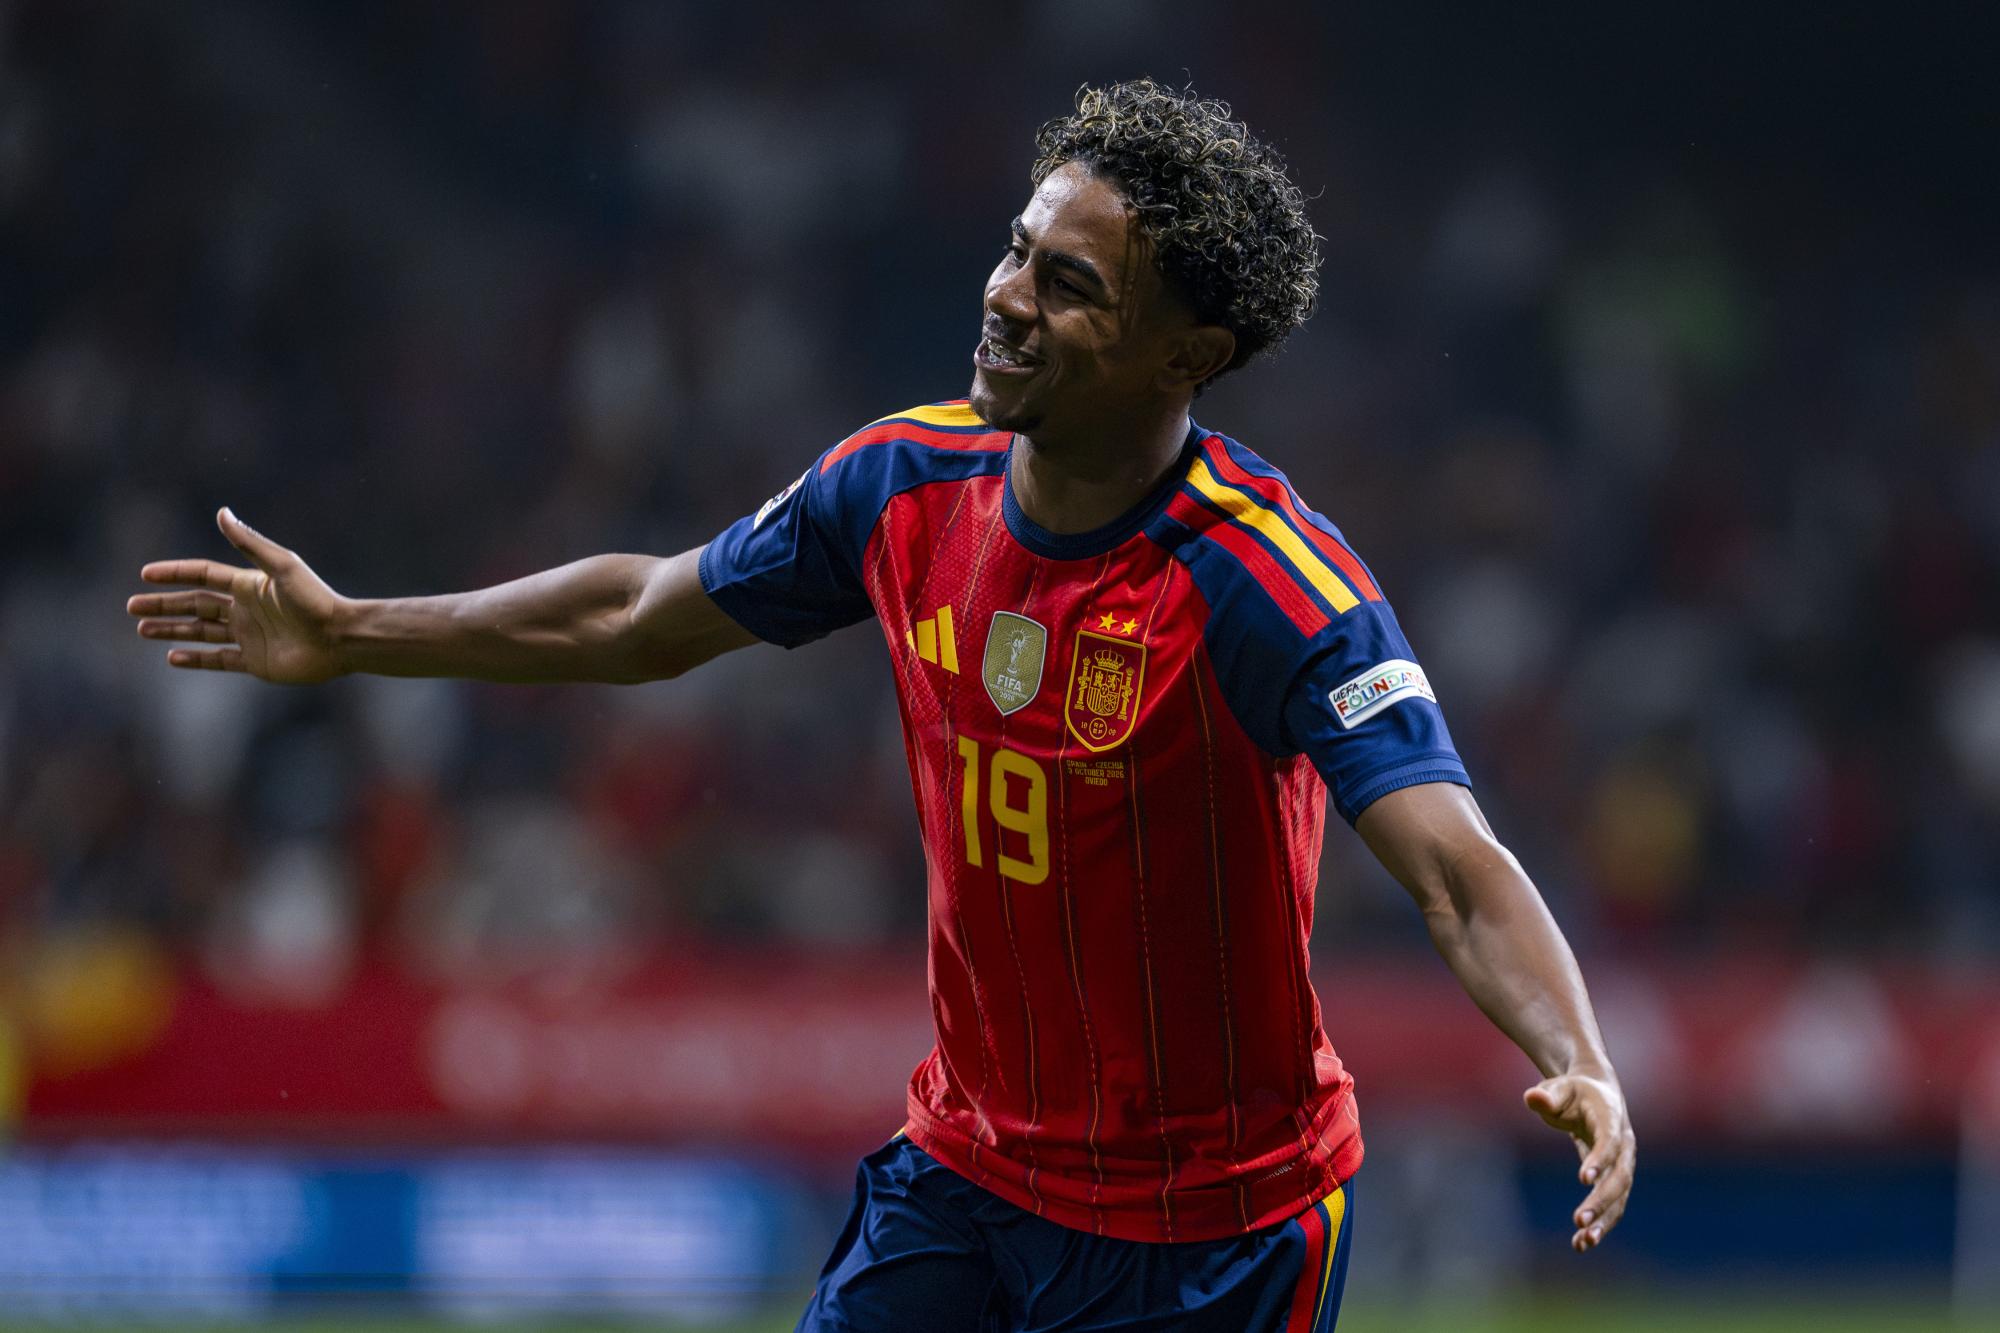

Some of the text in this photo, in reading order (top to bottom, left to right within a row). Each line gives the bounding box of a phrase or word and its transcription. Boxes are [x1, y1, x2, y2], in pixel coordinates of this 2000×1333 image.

[996, 674, 1021, 692] FIFA
[1333, 683, 1360, 702] UEFA
[1095, 761, 1124, 769] CZECHIA
[1075, 768, 1104, 777] OCTOBER
[1085, 776, 1109, 786] OVIEDO
[958, 735, 1050, 885] 19
